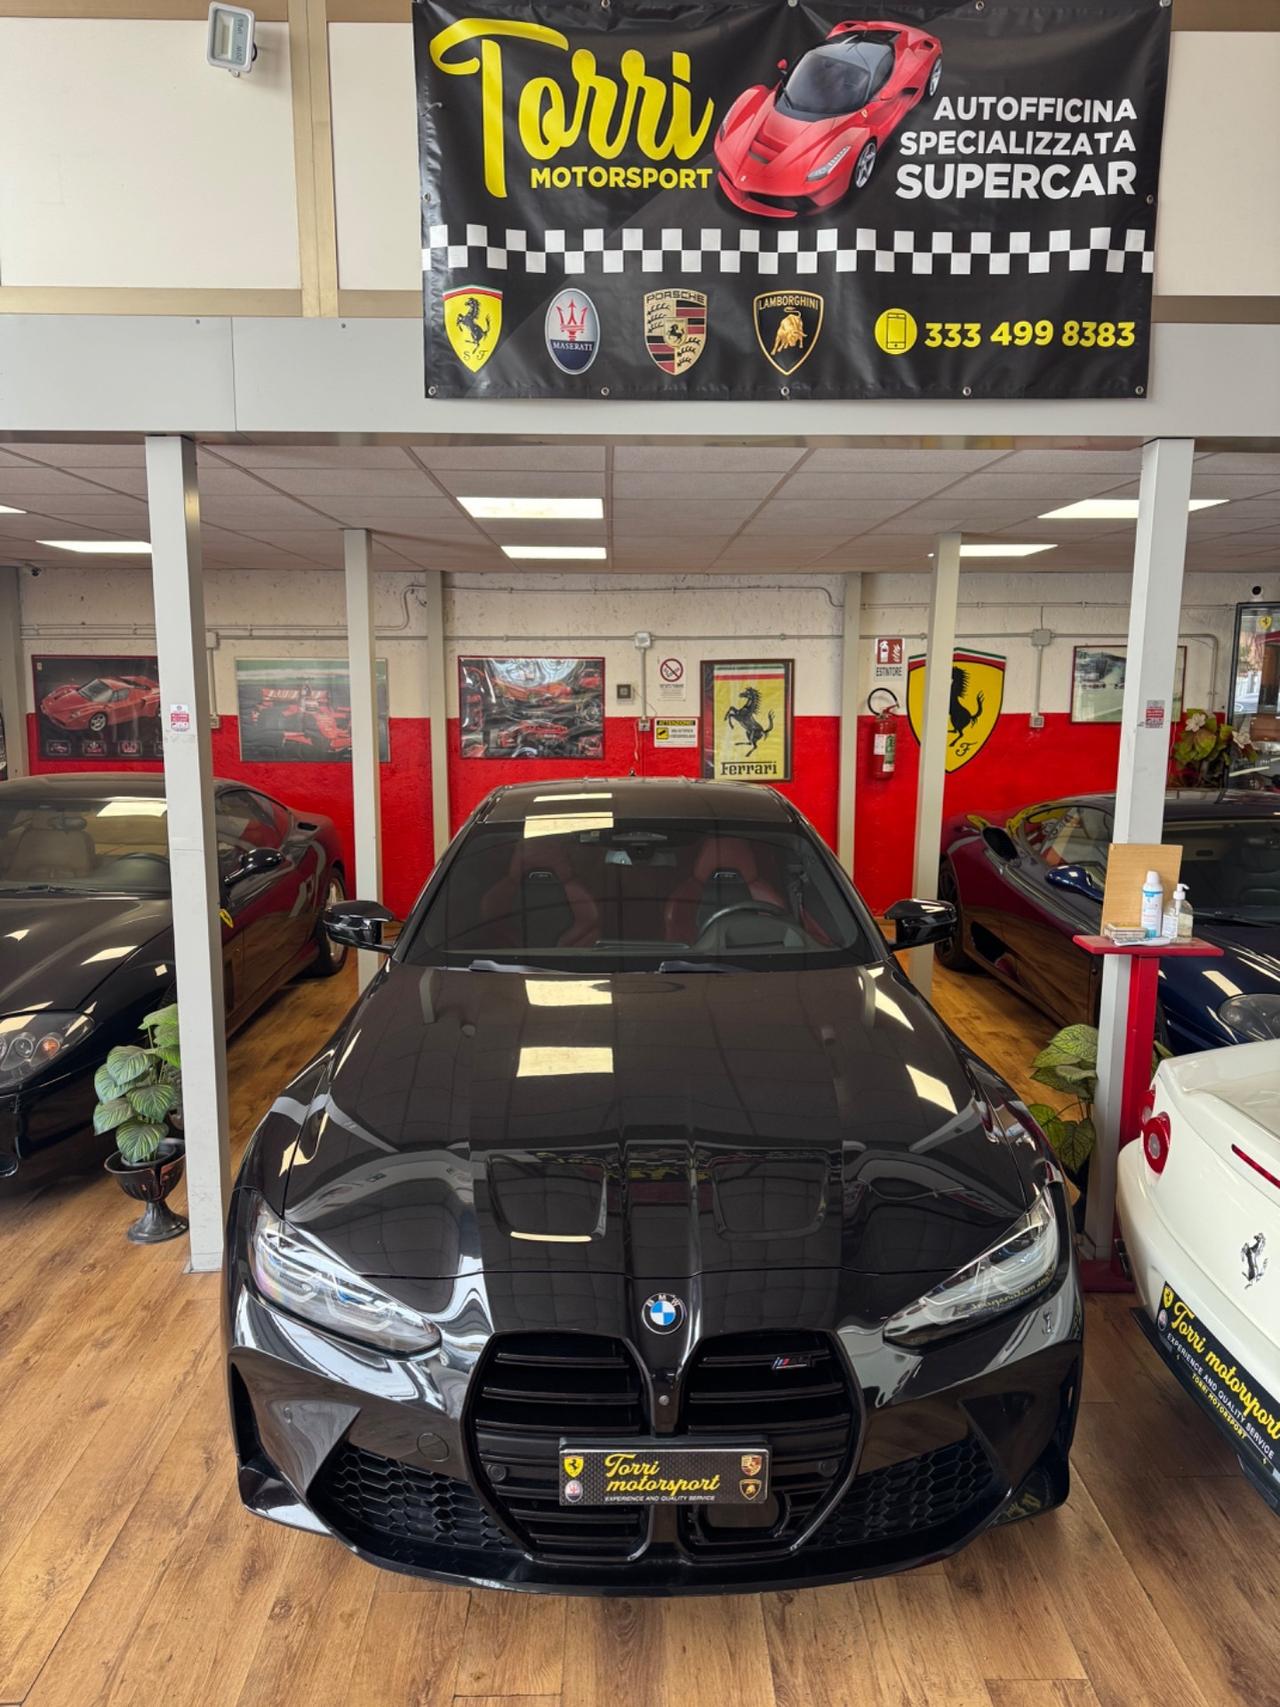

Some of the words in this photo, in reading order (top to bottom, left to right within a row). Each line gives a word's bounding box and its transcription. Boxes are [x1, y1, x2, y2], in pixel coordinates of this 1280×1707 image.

[429, 18, 714, 198] Torri
[933, 96, 1137, 122] AUTOFFICINA
[899, 130, 1136, 156] SPECIALIZZATA
[531, 166, 713, 189] MOTORSPORT
[895, 161, 1137, 199] SUPERCAR
[646, 290, 705, 304] PORSCHE
[758, 295, 819, 310] LAMBORGHINI
[552, 341, 593, 351] MASERATI
[924, 322, 981, 348] 333
[990, 320, 1054, 347] 499
[1061, 321, 1136, 348] 8383
[876, 667, 902, 676] ESTINTORE
[720, 761, 777, 775] Ferrari
[645, 1293, 682, 1308] BMW
[1171, 1301, 1206, 1354] Torri
[1205, 1350, 1280, 1440] motorsport
[1167, 1333, 1204, 1376] EXPERIENCE
[1202, 1375, 1218, 1392] AND
[1218, 1390, 1247, 1423] QUALITY
[1246, 1422, 1275, 1459] SERVICE
[1192, 1373, 1208, 1396] TORRI
[1208, 1392, 1247, 1439] MOTORSPORT
[604, 1453, 659, 1478] Torri
[606, 1474, 720, 1496] motorsport
